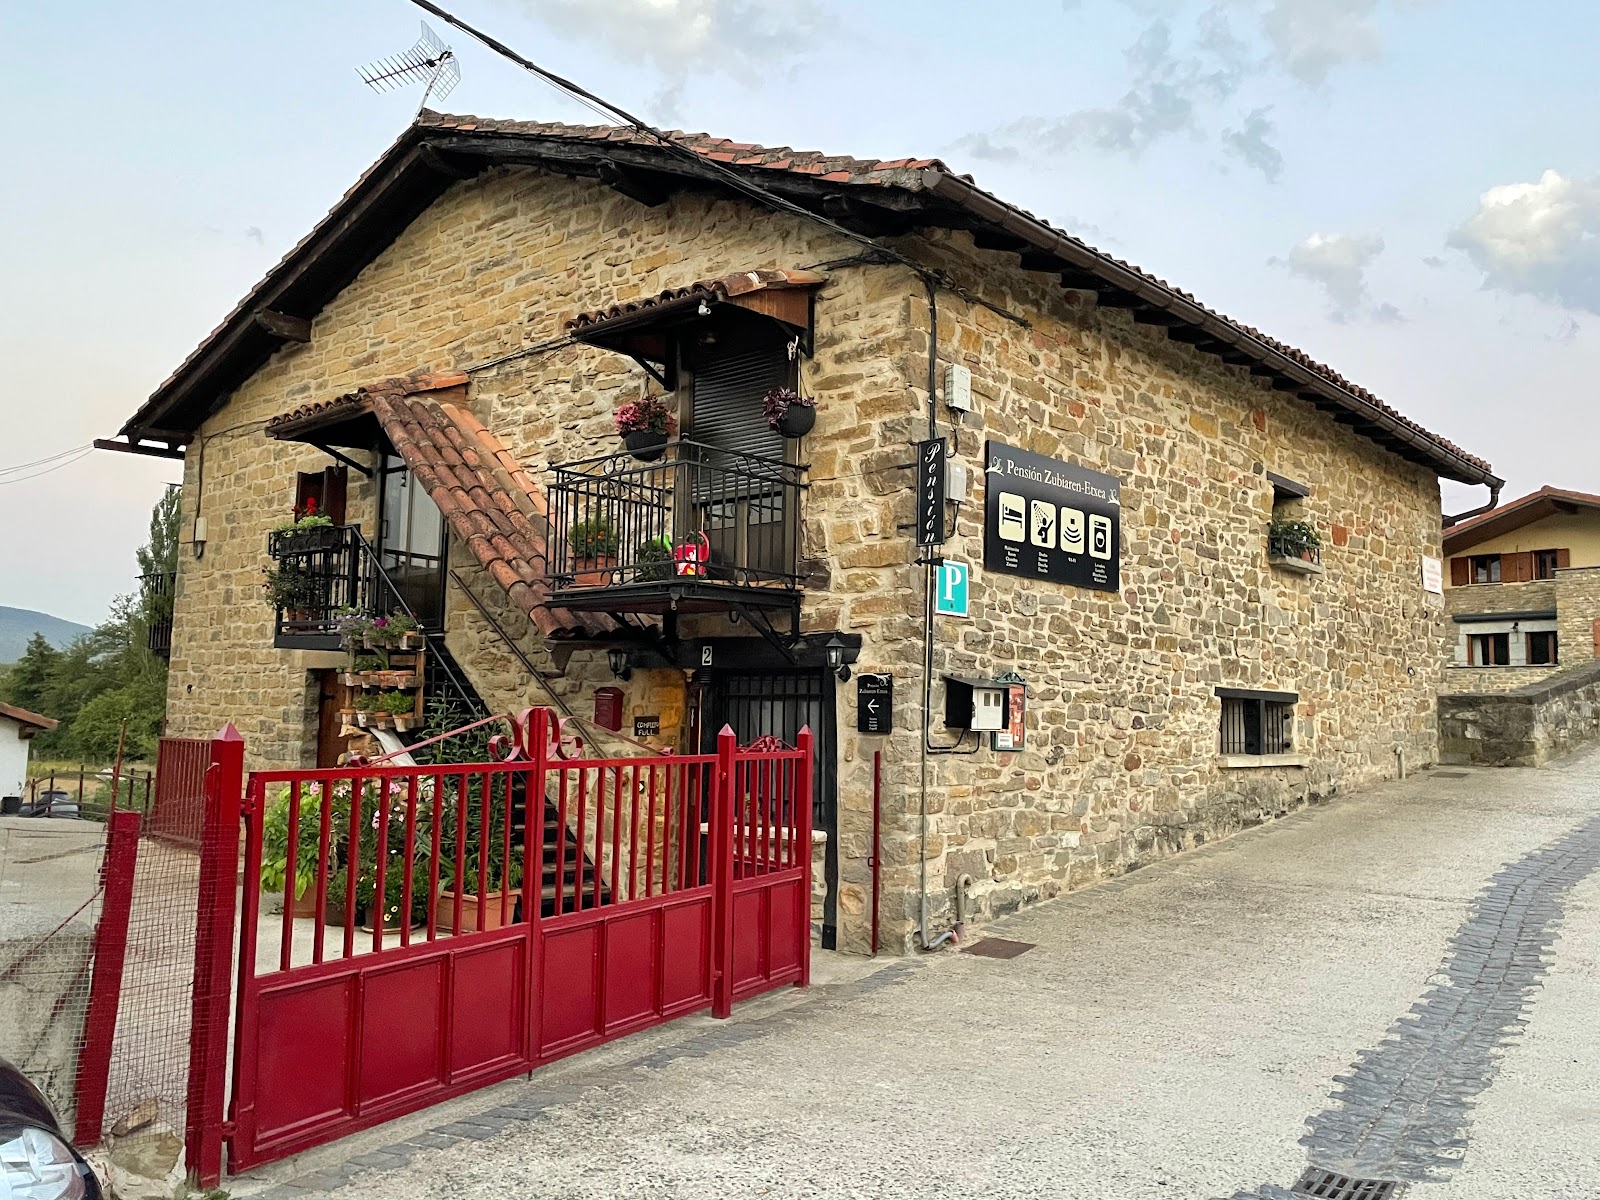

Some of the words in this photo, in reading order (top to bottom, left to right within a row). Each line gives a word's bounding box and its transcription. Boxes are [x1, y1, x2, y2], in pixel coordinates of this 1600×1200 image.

[1007, 459, 1042, 482] Pensión
[924, 442, 941, 543] Pensión
[943, 564, 962, 601] P
[703, 647, 711, 664] 2
